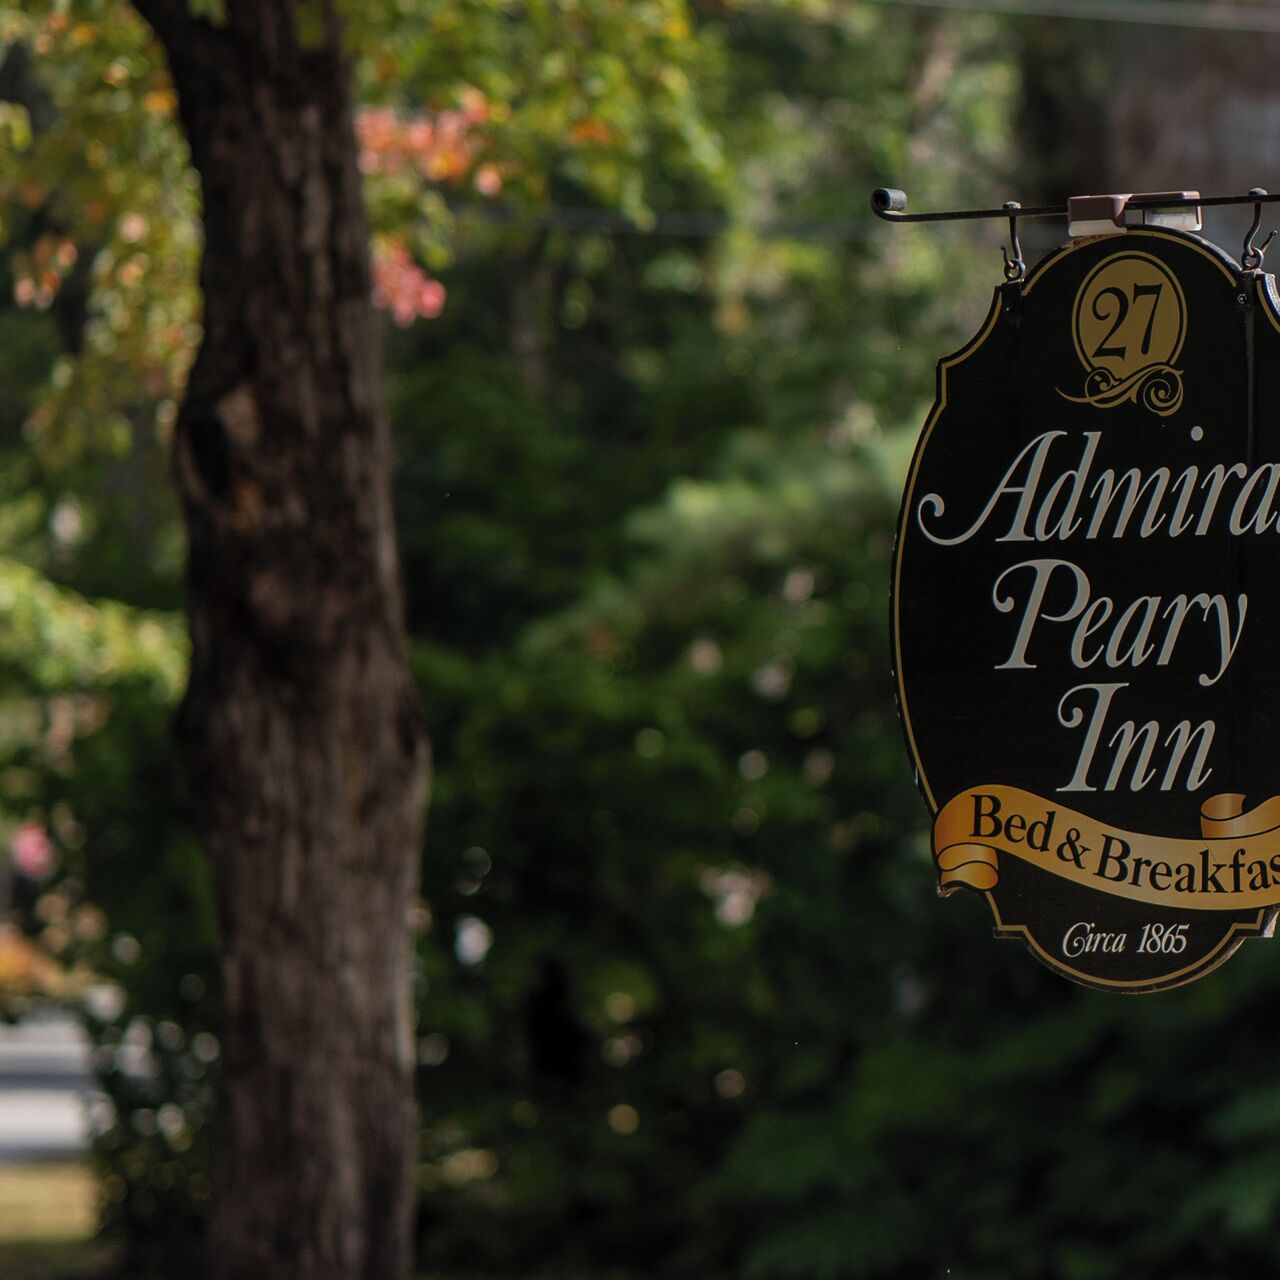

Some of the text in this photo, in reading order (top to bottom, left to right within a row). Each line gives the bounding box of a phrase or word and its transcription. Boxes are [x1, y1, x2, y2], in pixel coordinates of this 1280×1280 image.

[1091, 282, 1164, 361] 27
[992, 558, 1248, 687] Peary
[1055, 682, 1216, 792] Inn
[969, 793, 1056, 852] Bed
[1062, 922, 1190, 957] Circa 1865
